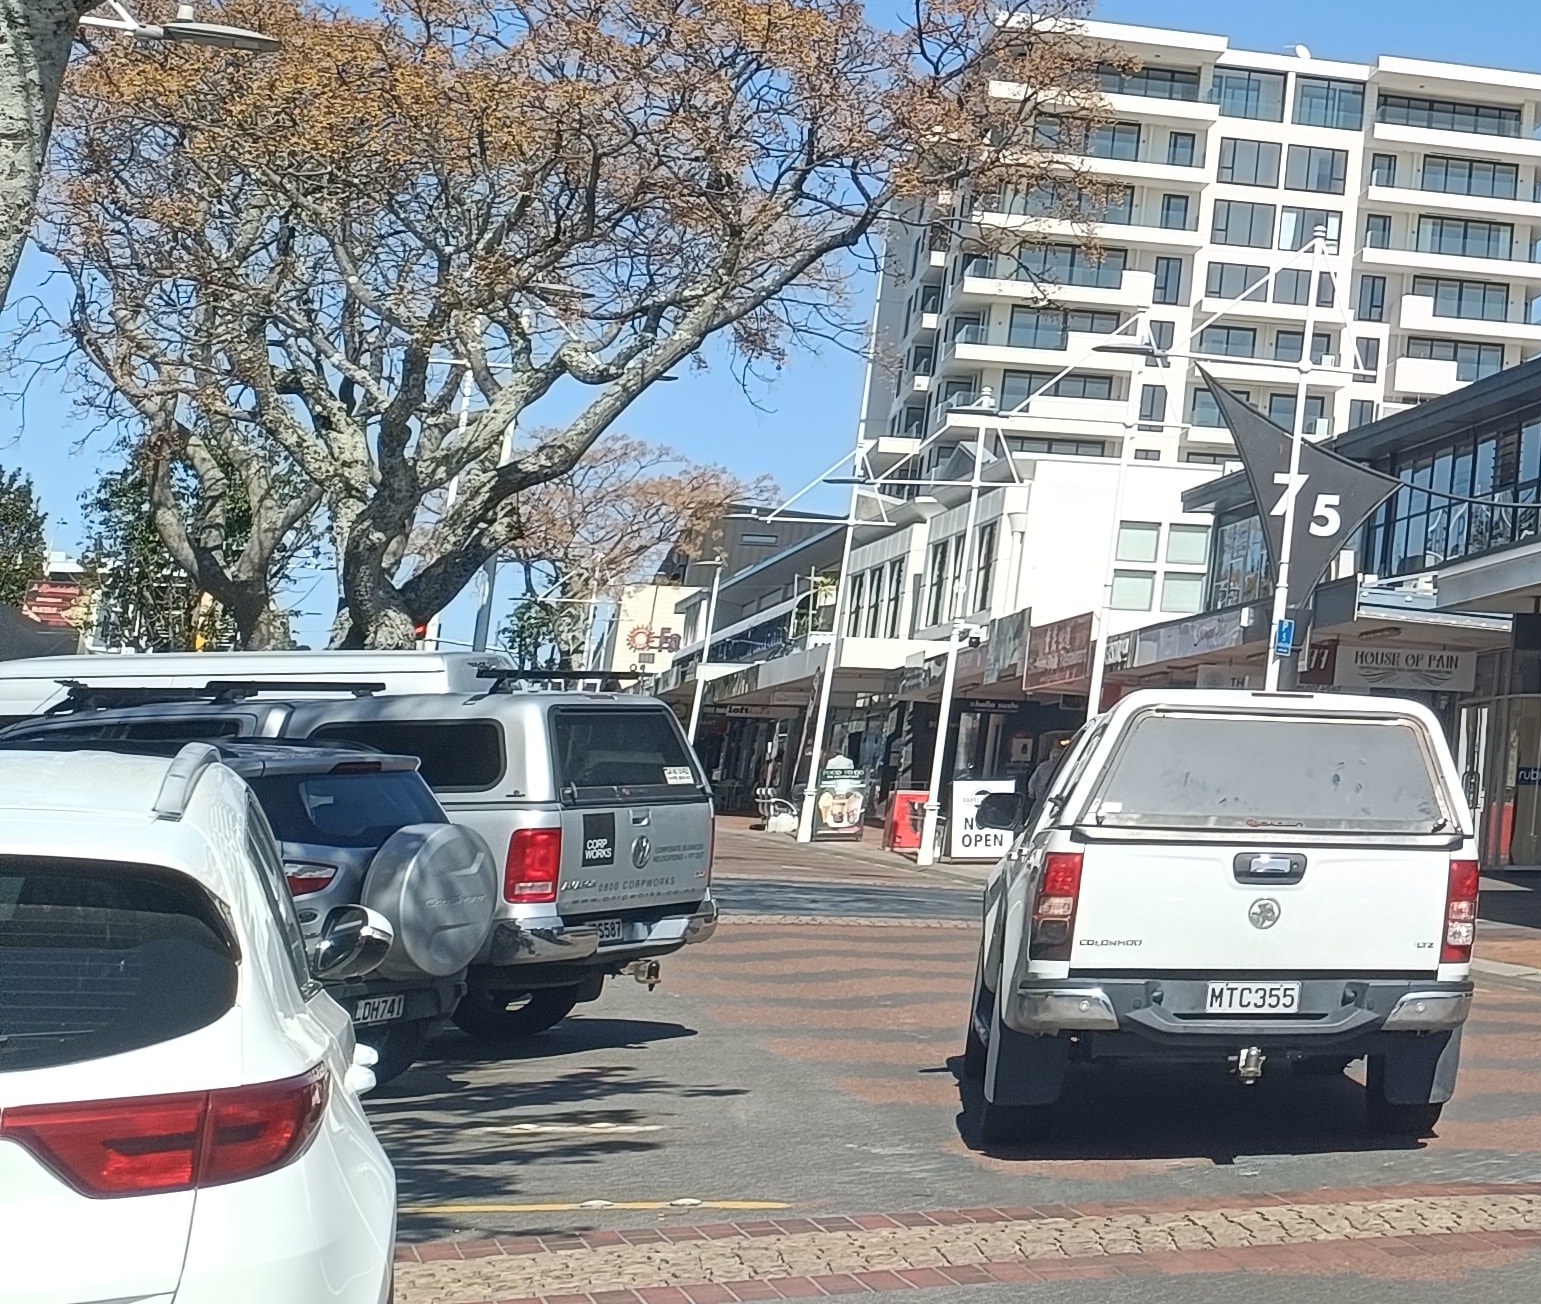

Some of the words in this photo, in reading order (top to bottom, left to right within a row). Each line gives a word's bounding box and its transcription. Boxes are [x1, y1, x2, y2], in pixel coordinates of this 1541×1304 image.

[1282, 621, 1290, 632] P
[1354, 650, 1400, 666] HOUSE
[1405, 652, 1425, 667] OF
[1428, 654, 1459, 670] PAIN
[728, 705, 750, 714] loft
[586, 838, 608, 849] CORP
[961, 833, 1004, 848] OPEN
[584, 847, 612, 860] WORKS
[598, 882, 619, 893] 0800
[622, 876, 676, 890] CORPWORKS
[590, 921, 622, 939] S587
[1209, 984, 1296, 1010] MTC355
[353, 998, 401, 1022] LDH741
